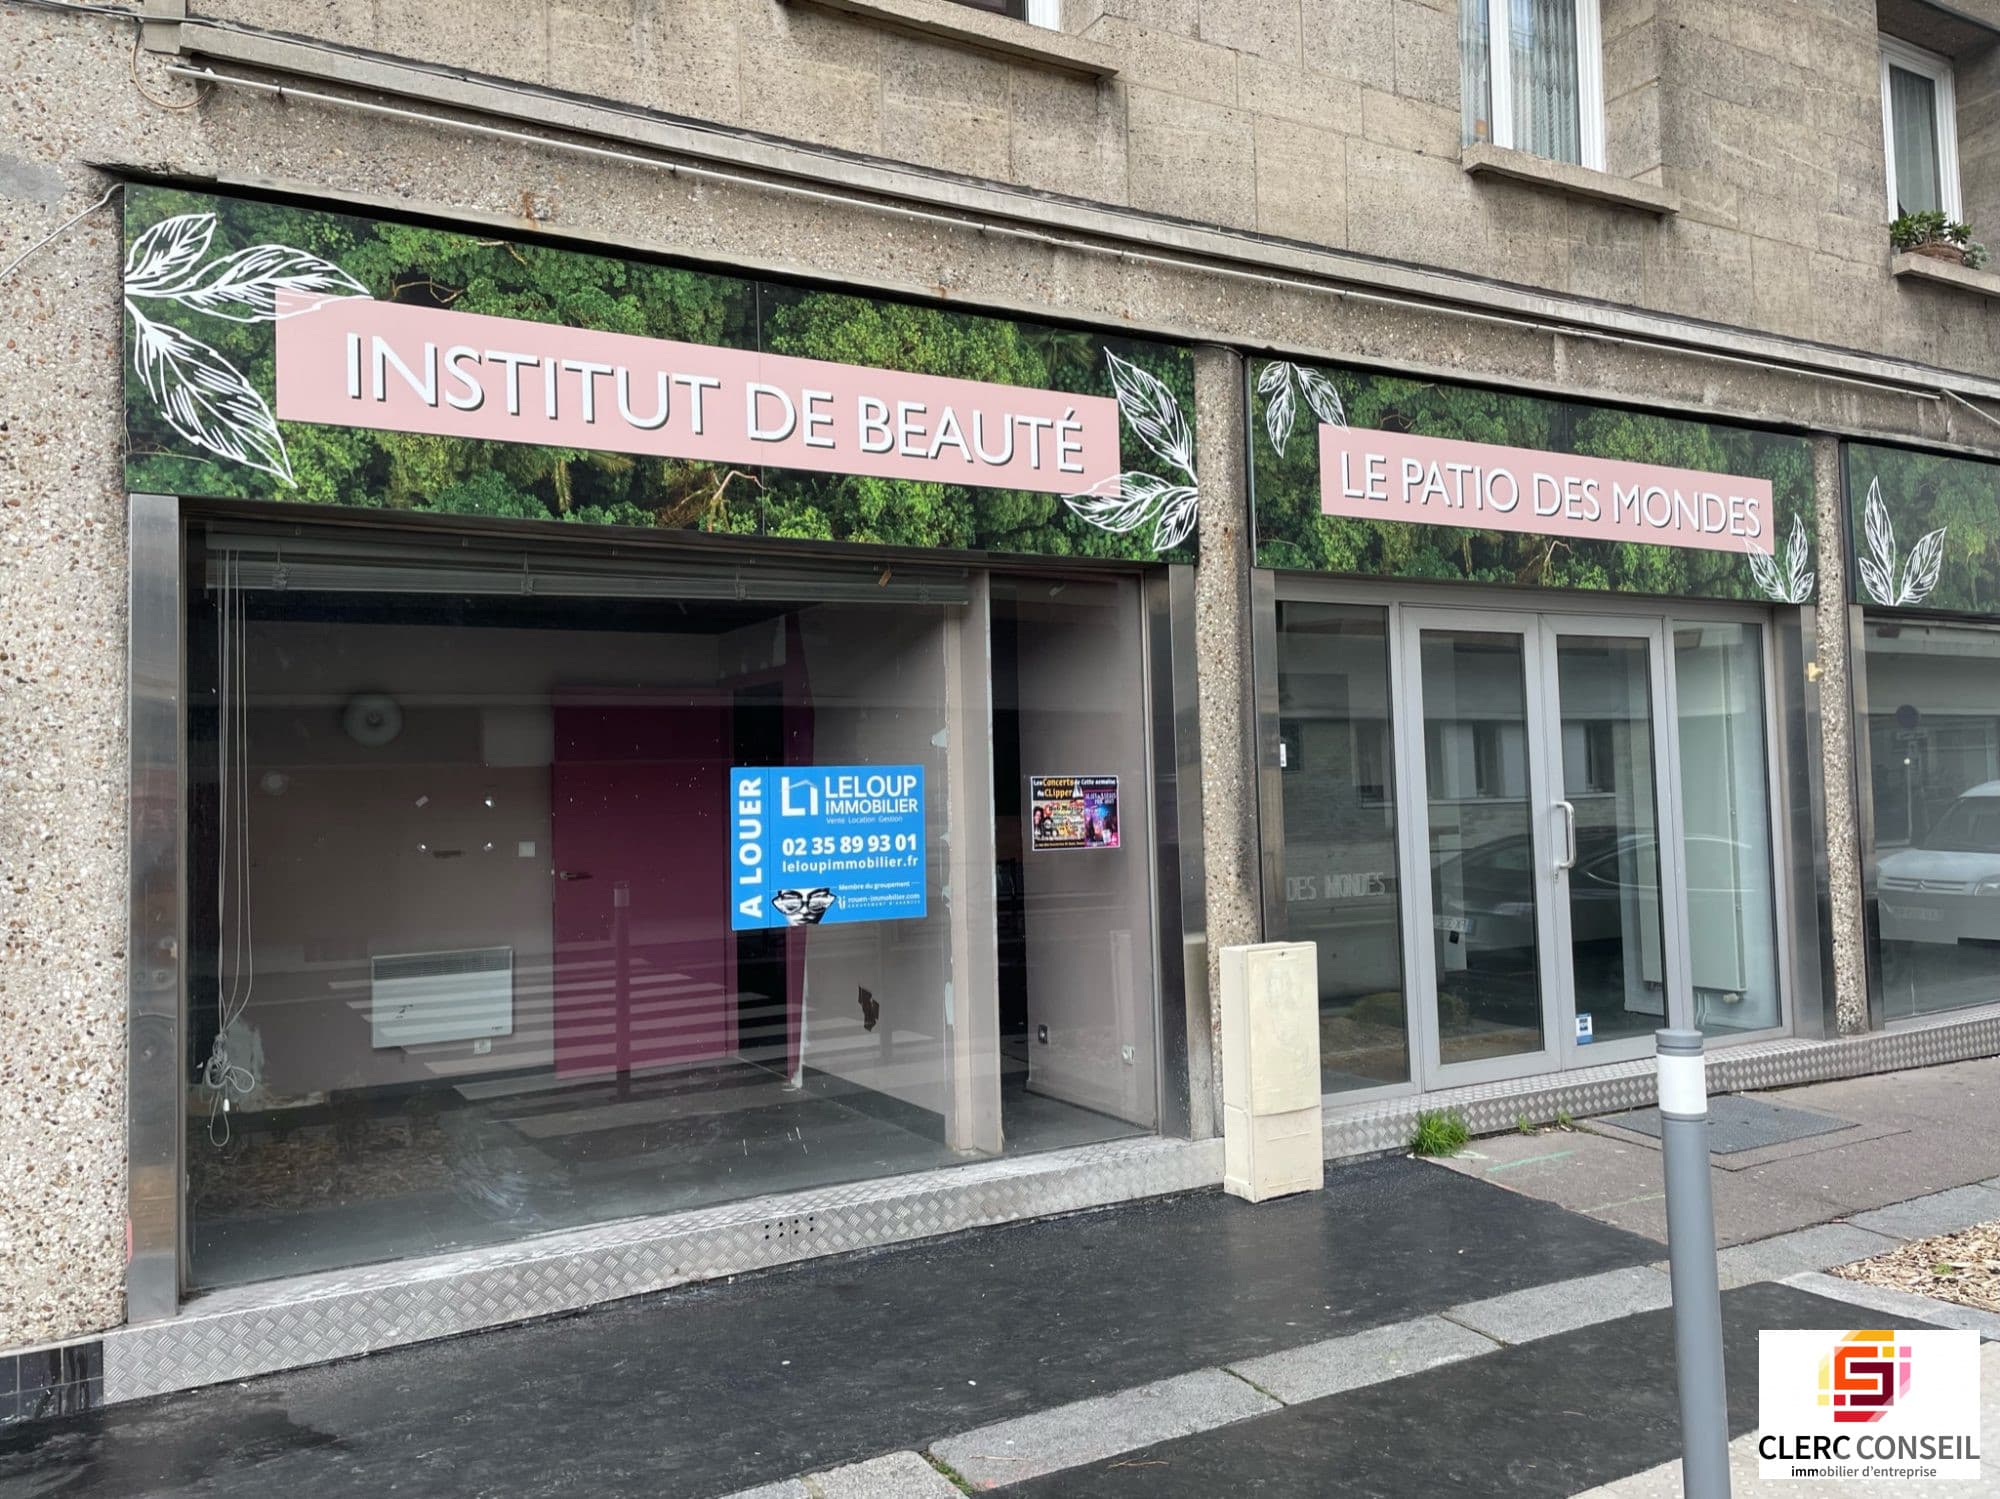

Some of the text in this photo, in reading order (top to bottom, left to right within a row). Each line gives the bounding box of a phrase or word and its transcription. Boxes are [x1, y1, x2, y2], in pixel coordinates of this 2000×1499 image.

[346, 332, 1085, 474] INSTITUT DE BEAUTÉ
[1340, 450, 1763, 538] LE PATIO DES MONDES
[825, 776, 917, 798] LELOUP
[826, 799, 918, 814] IMMOBILIER
[848, 815, 876, 825] Location
[878, 814, 903, 824] Gestion
[739, 778, 762, 918] A LOUER
[782, 833, 917, 856] 02 35 89 93 01
[782, 855, 919, 874] leloupimmobilier.fr
[838, 880, 911, 891] Membre du groupement
[1324, 872, 1386, 898] MONDES
